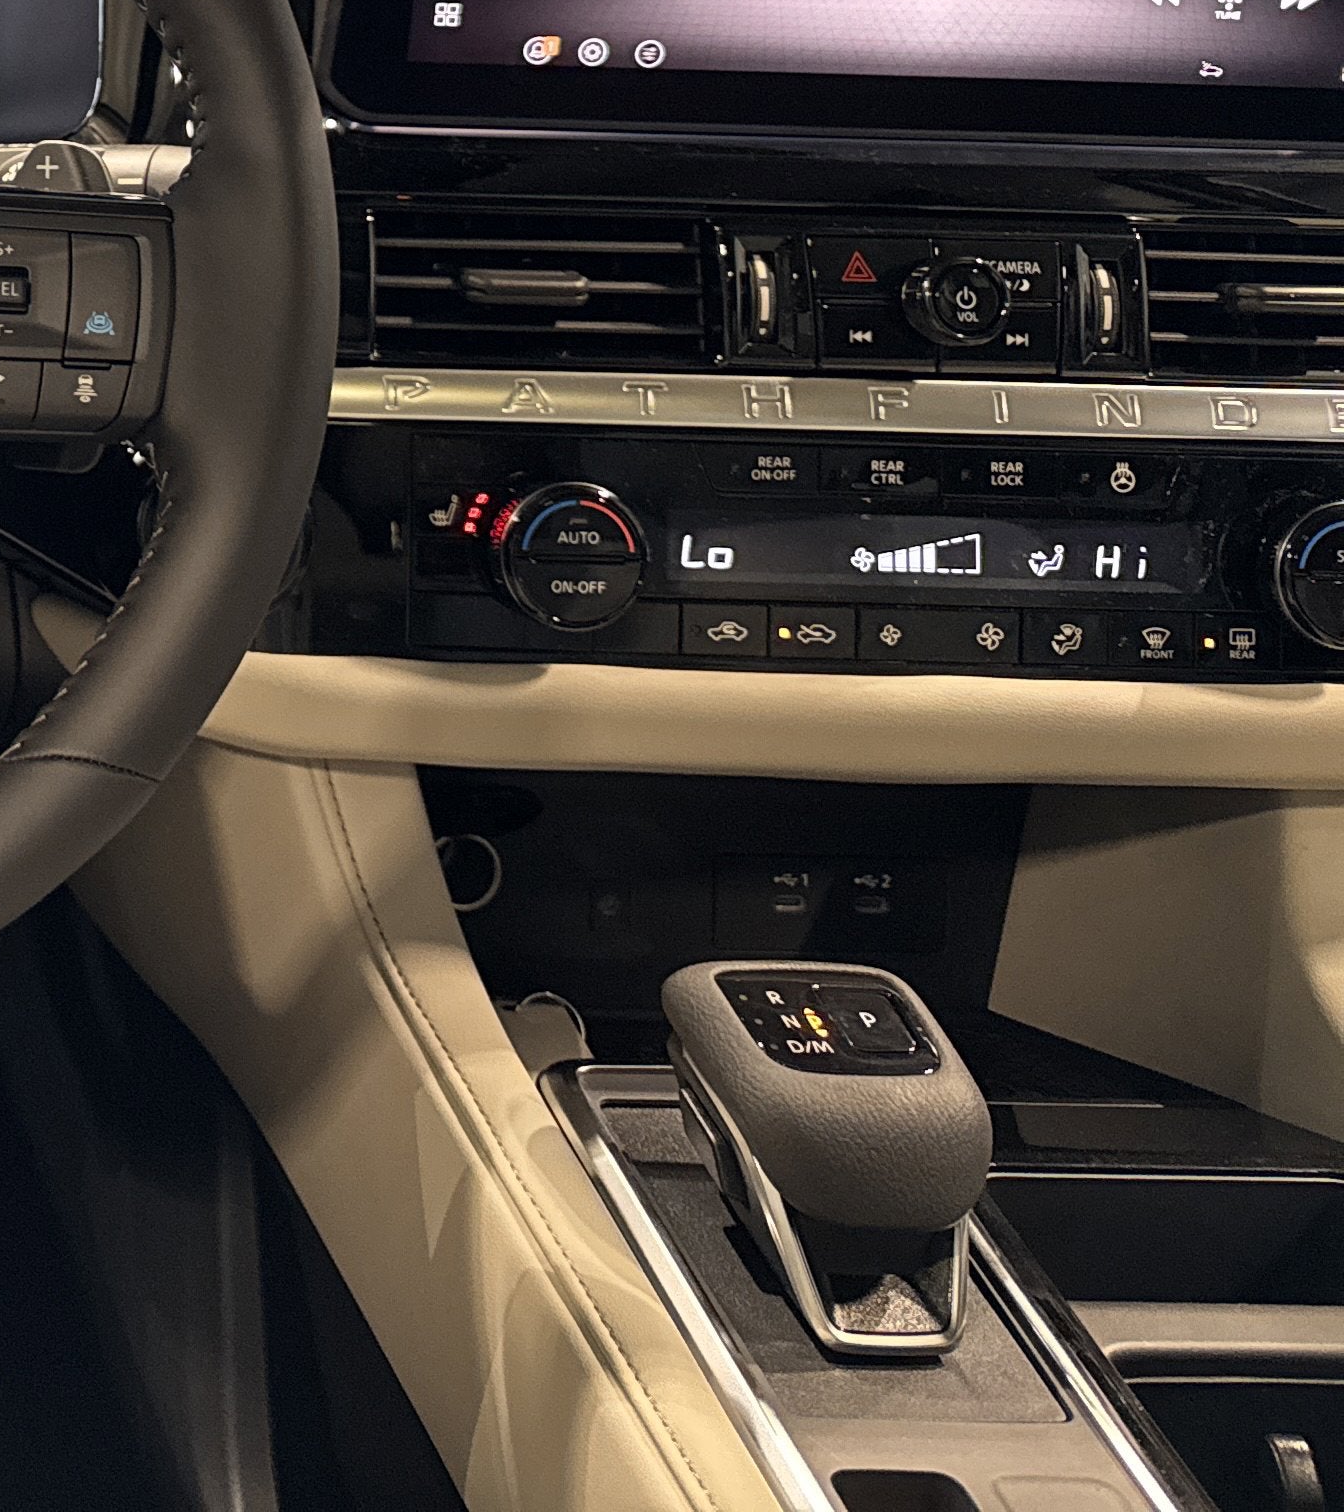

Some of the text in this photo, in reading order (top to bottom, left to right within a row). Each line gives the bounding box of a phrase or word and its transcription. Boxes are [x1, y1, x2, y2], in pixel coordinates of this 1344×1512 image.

[956, 311, 980, 323] VOL
[757, 456, 792, 469] REAR
[870, 460, 905, 472] REAR
[990, 461, 1024, 474] REAR
[870, 473, 905, 486] CTRL
[990, 474, 1024, 486] LOCK
[556, 530, 600, 545] AUTO
[680, 533, 735, 570] Lo
[1140, 649, 1175, 660] FRONT
[1229, 649, 1256, 660] REAR
[765, 990, 785, 1005] R
[780, 1014, 802, 1029] N
[858, 1011, 877, 1028] P
[786, 1039, 835, 1054] D/M
